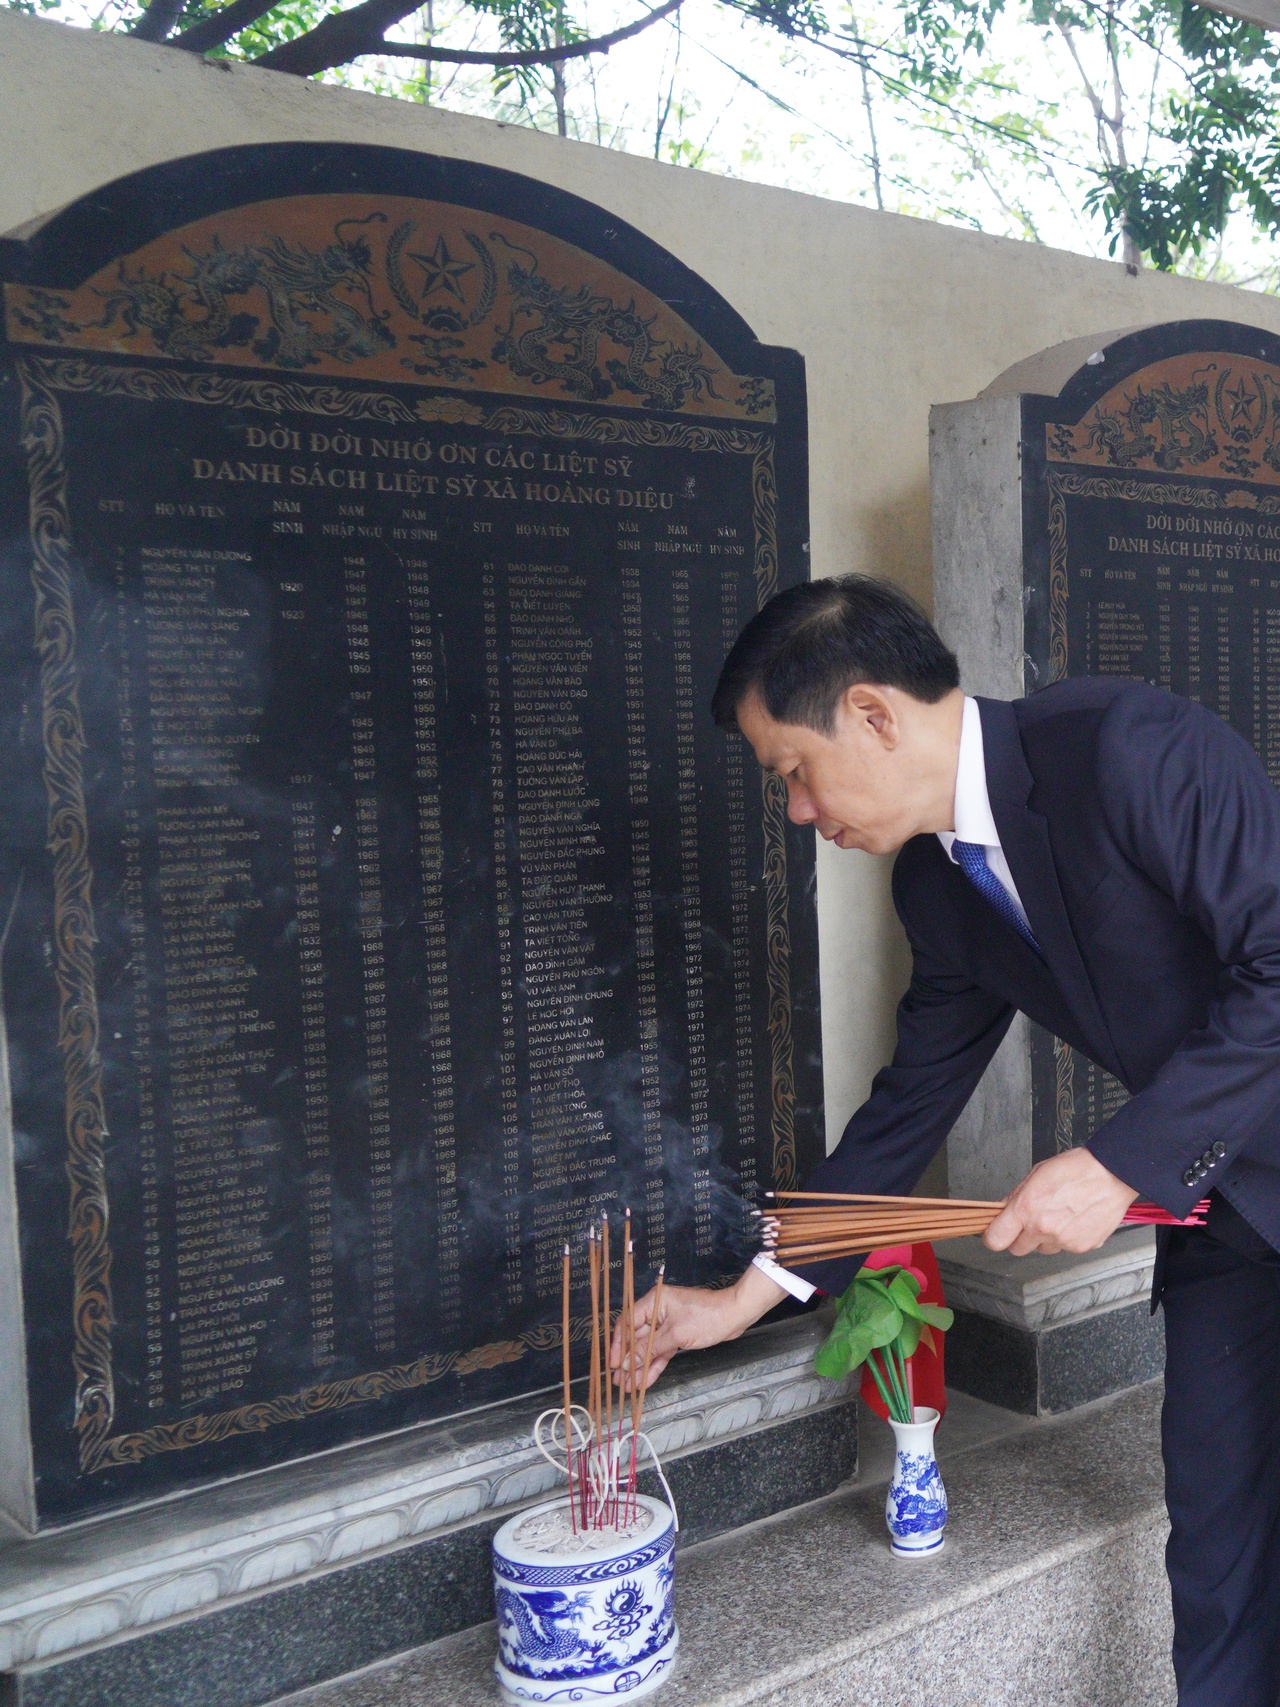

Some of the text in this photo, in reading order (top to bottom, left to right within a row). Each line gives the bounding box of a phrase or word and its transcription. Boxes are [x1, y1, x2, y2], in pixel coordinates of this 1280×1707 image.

[246, 422, 633, 478] ĐỜI ĐỜI NHỚ ƠN CÁC LIỆT SỸ
[192, 458, 674, 513] DANH SÁCH LIỆT SỸ XÃ HOÀNG DIỆU
[272, 521, 304, 534] SINH
[473, 521, 493, 533] STT
[1146, 510, 1173, 531] ĐỜI
[1175, 513, 1200, 533] ĐỜI
[1203, 517, 1232, 536] NHỚ
[393, 527, 438, 541] HY SINH
[516, 523, 532, 537] HỌ
[617, 540, 641, 551] SINH
[710, 544, 745, 555] HY SINH
[1108, 536, 1149, 555] DANH
[1152, 536, 1189, 556] SÁCH
[1193, 539, 1223, 561] LIỆT
[1225, 542, 1242, 560] SỸ
[406, 559, 428, 568] 1948
[344, 570, 366, 579] 1947
[407, 572, 429, 581] 1948
[1080, 568, 1092, 578] STT
[280, 582, 303, 592] 1920
[408, 585, 430, 595] 1948
[1156, 581, 1172, 591] SINH
[408, 598, 430, 608] 1949
[623, 628, 642, 637] 1952
[673, 629, 691, 637] 1970
[410, 638, 432, 647] 1949
[348, 651, 370, 660] 1945
[411, 651, 433, 660] 1950
[624, 652, 643, 661] 1947
[349, 664, 371, 674] 1950
[411, 664, 433, 673] 1950
[625, 664, 643, 673] 1941
[675, 664, 692, 673] 1962
[625, 676, 644, 685] 1954
[675, 676, 693, 684] 1970
[676, 700, 693, 708] 1969
[489, 715, 501, 724] 73
[567, 714, 579, 722] AN
[627, 712, 645, 721] 1944
[572, 726, 583, 735] BA
[676, 722, 694, 731] 1967
[490, 728, 501, 737] 74
[627, 736, 646, 745] 1947
[628, 748, 646, 757] 1954
[677, 746, 694, 755] 1971
[490, 753, 502, 762] 76
[726, 756, 743, 764] 1972
[491, 766, 502, 774] 77
[516, 765, 535, 774] CAO
[726, 767, 743, 776] 1972
[492, 790, 504, 800] 79
[630, 795, 649, 805] 1949
[492, 804, 504, 813] 80
[577, 798, 600, 809] LONG
[631, 819, 649, 828] 1950
[493, 829, 505, 838] 82
[557, 837, 578, 846] MINH
[631, 843, 650, 852] 1942
[559, 885, 576, 894] HUY
[634, 902, 652, 911] 1951
[523, 913, 541, 923] CAO
[635, 913, 653, 923] 1952
[363, 955, 385, 965] 1965
[499, 954, 511, 963] 92
[685, 954, 702, 963] 1972
[363, 968, 384, 978] 1967
[364, 981, 386, 991] 1966
[584, 989, 614, 1001] CHUNG
[686, 988, 703, 998] 1971
[364, 993, 386, 1004] 1967
[502, 1003, 513, 1012] 96
[687, 999, 704, 1009] 1972
[687, 1011, 705, 1020] 1973
[688, 1022, 704, 1032] 1971
[586, 1038, 604, 1047] NAM
[499, 1052, 516, 1062] 100
[689, 1056, 706, 1066] 1973
[500, 1065, 515, 1074] 101
[501, 1076, 516, 1086] 102
[502, 1113, 518, 1123] 105
[739, 1125, 755, 1135] 1975
[588, 1155, 616, 1167] TRUNG
[692, 1169, 710, 1178] 1974
[308, 1186, 332, 1198] 1950
[308, 1200, 333, 1211] 1944
[308, 1213, 331, 1225] 1951
[504, 1210, 520, 1221] 112
[143, 1217, 158, 1228] 47
[437, 1222, 459, 1235] 1970
[438, 1236, 459, 1247] 1970
[146, 1287, 161, 1298] 52
[148, 1355, 163, 1367] 57
